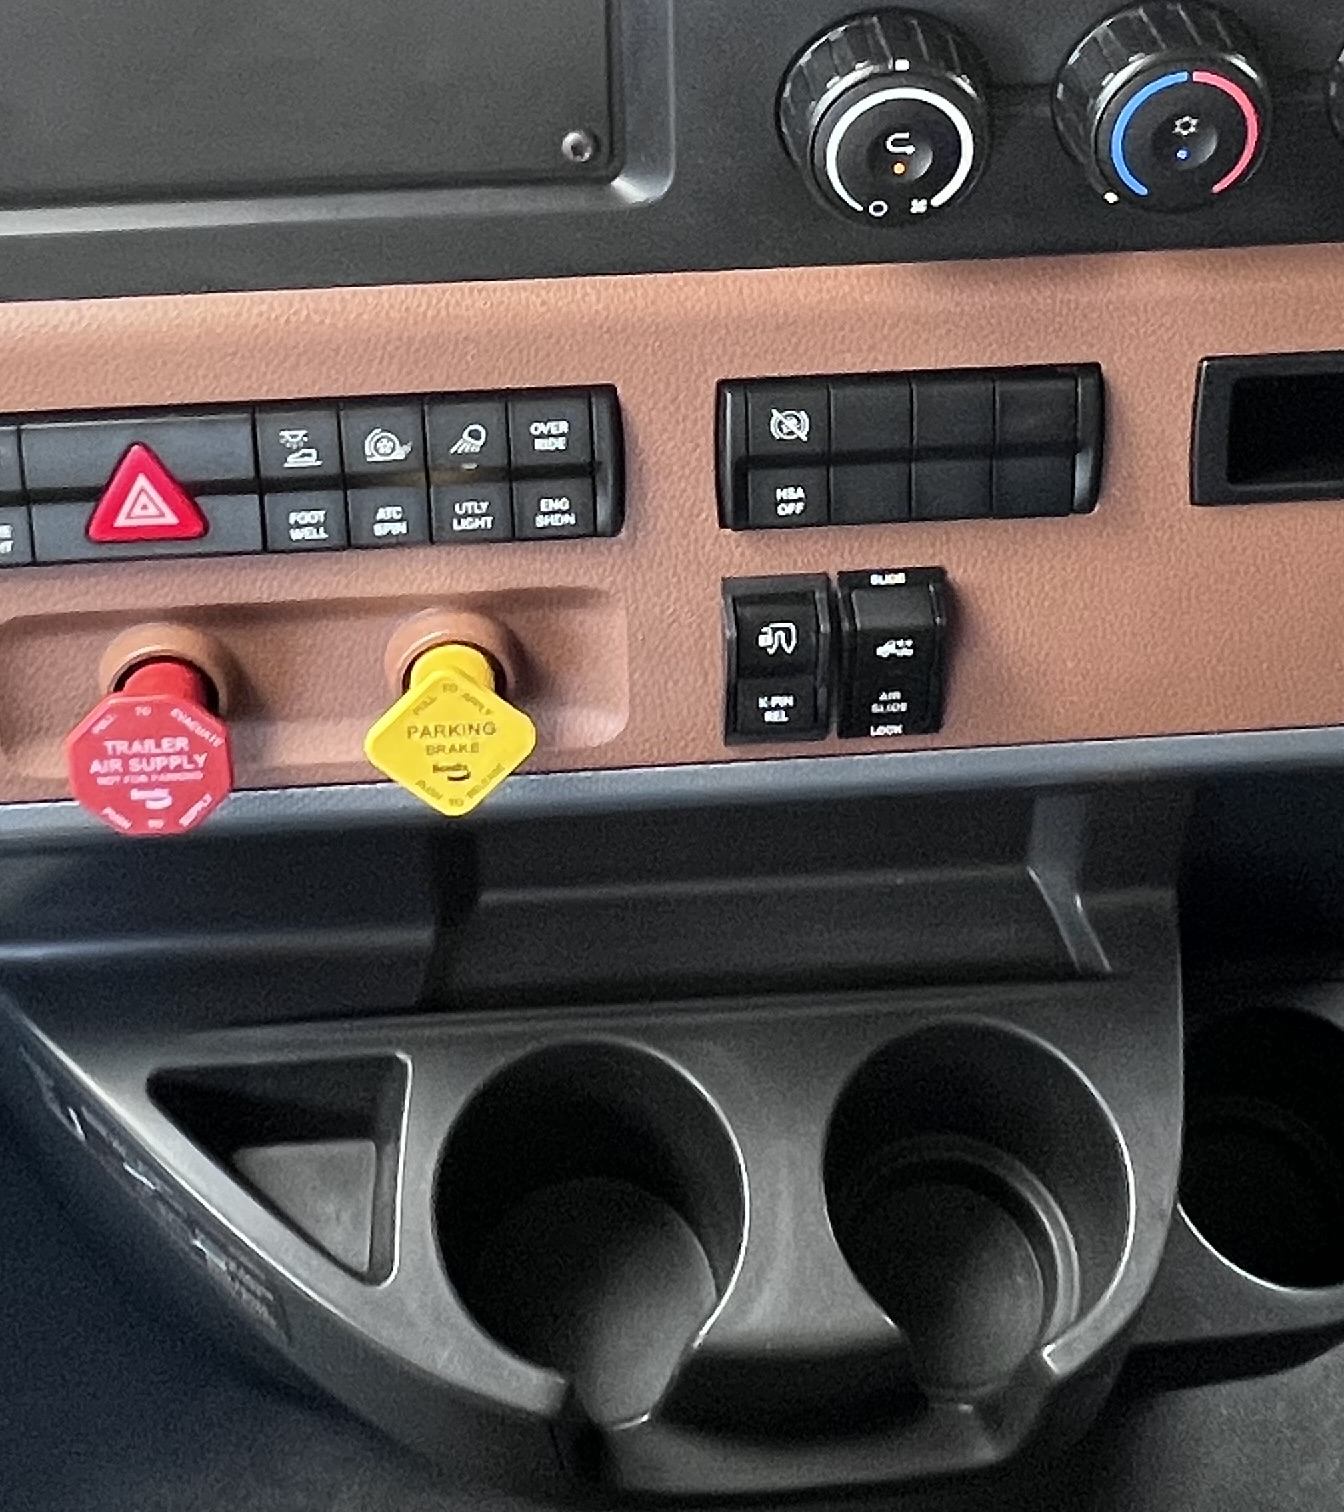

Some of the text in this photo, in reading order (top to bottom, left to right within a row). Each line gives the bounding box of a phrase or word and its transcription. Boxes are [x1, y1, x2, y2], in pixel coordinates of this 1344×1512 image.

[529, 420, 569, 435] OVER
[454, 501, 490, 515] UTLY
[540, 497, 570, 512] ENG
[777, 502, 805, 516] OFF
[288, 510, 327, 525] FOOT
[452, 516, 494, 531] LIGHT
[288, 526, 329, 541] WELL
[407, 722, 497, 739] PARKING
[104, 737, 190, 756] TRAILER
[426, 743, 479, 756] BRAKE
[89, 752, 208, 774] AIR SUPPLY
